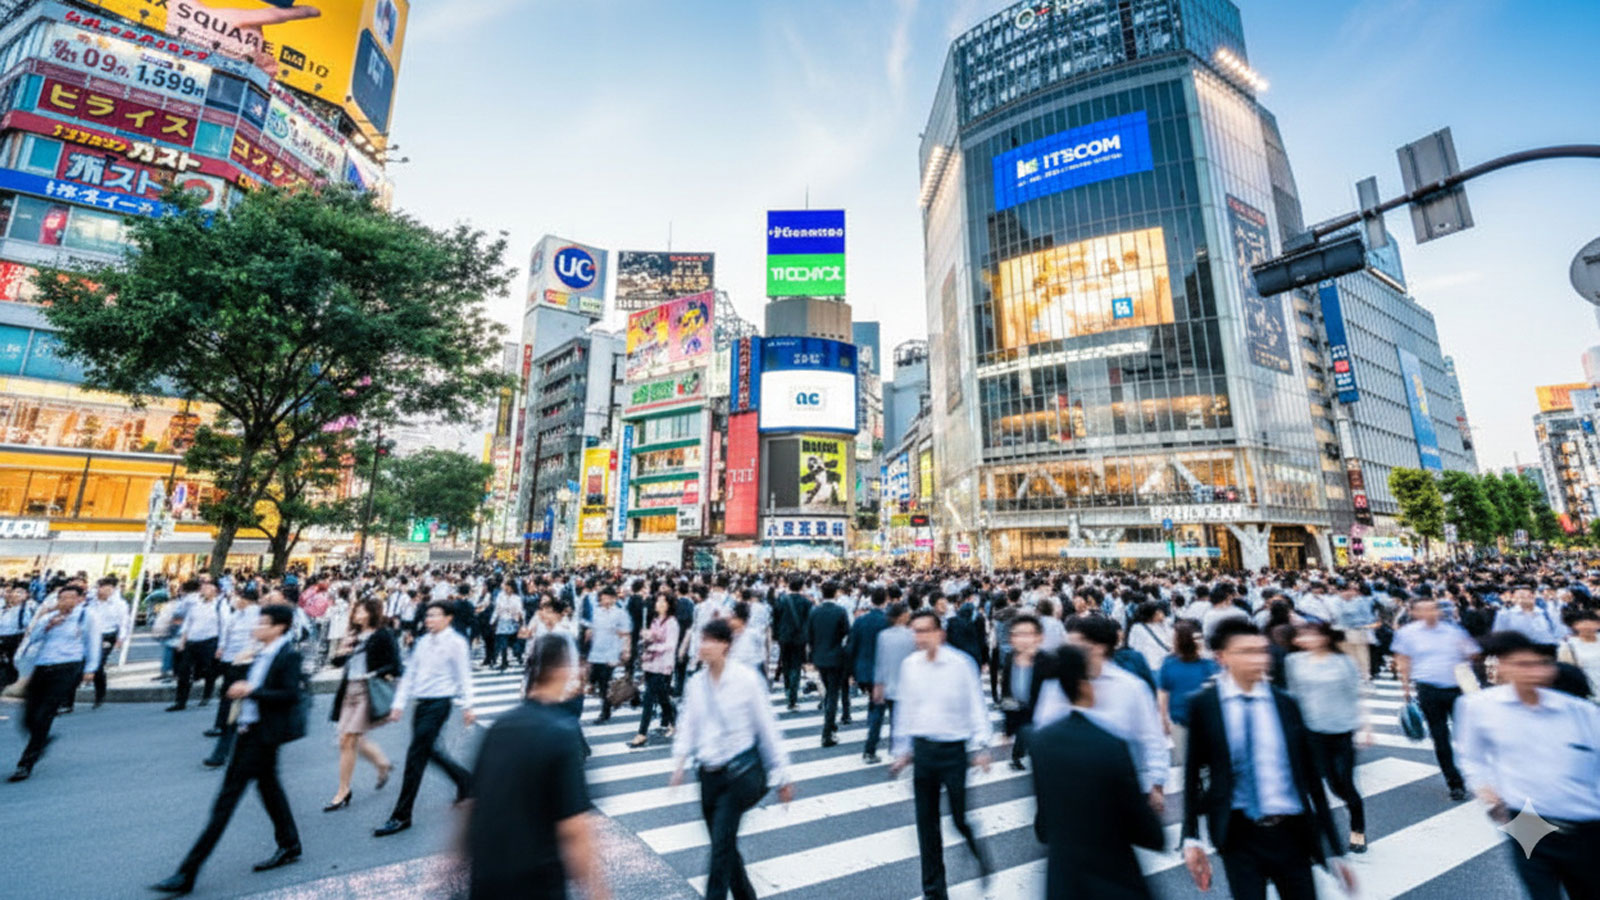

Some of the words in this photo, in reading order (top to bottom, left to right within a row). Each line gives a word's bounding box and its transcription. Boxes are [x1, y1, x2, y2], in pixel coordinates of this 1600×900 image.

[50, 84, 189, 138] ビライス
[559, 254, 593, 282] UC
